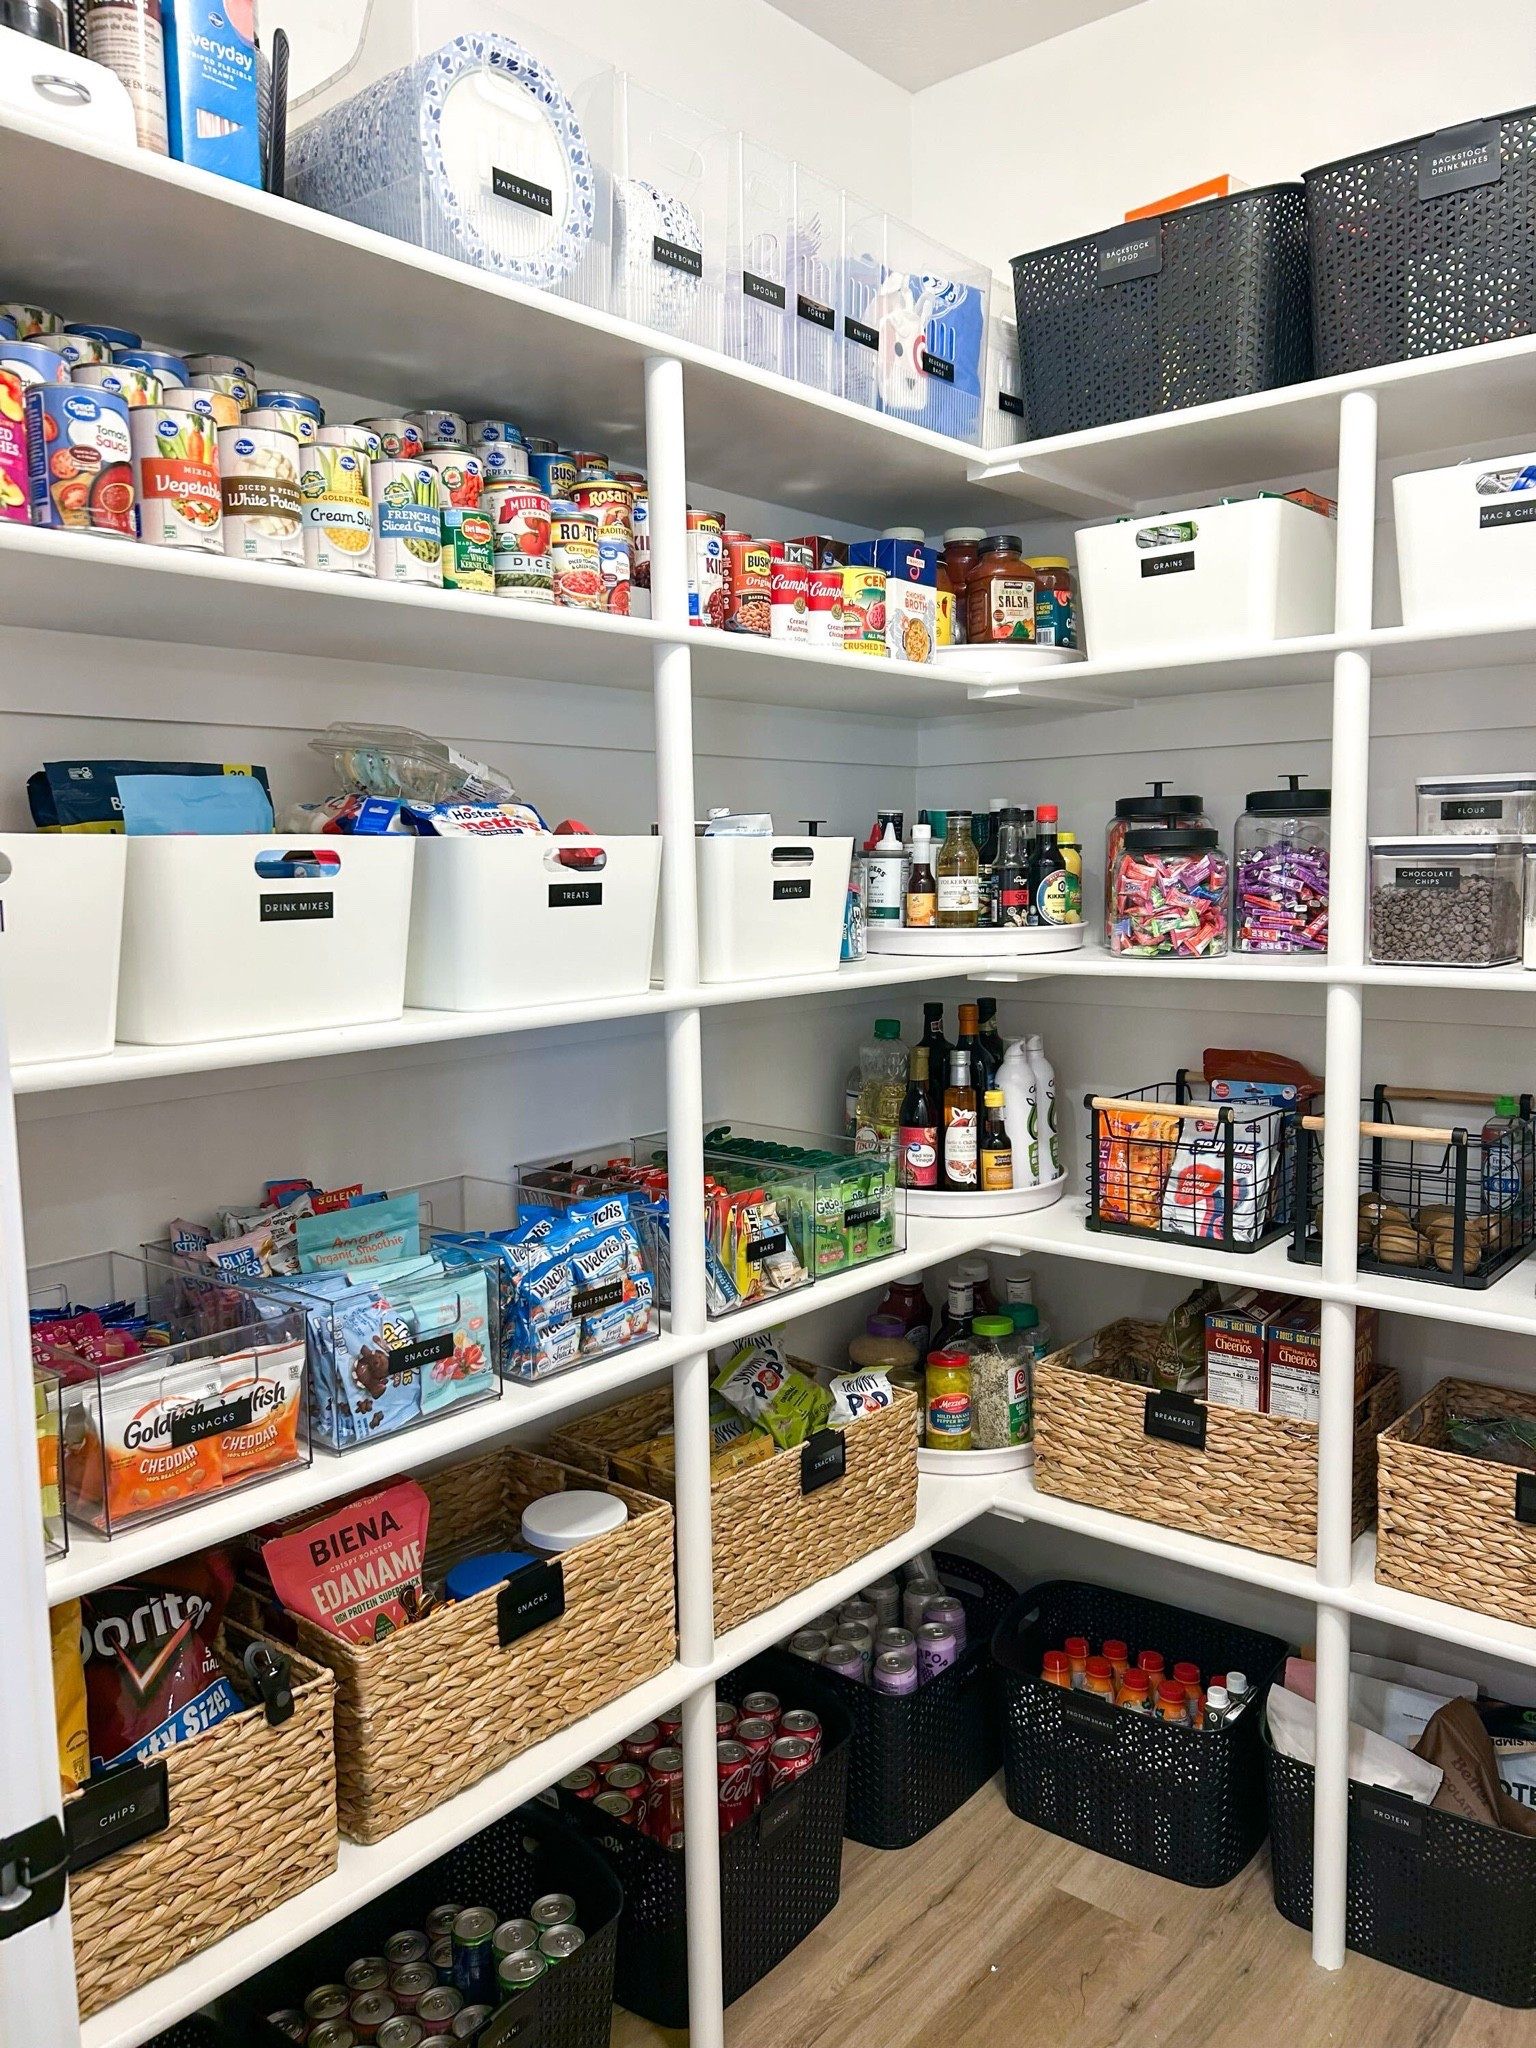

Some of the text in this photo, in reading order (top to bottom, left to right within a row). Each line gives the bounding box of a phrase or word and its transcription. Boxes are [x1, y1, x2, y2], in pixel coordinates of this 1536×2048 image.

[203, 64, 234, 82] STRAWS
[1432, 146, 1487, 167] BACKSTOCK
[1431, 155, 1488, 176] DRINK MIXES
[496, 178, 550, 206] PAPER PLATES
[657, 246, 700, 269] PAPER BOWLS
[1106, 241, 1150, 259] BACKSTOCK
[1117, 252, 1139, 264] FOOD
[752, 283, 778, 299] SPOONS
[807, 307, 826, 320] FORKS
[853, 327, 872, 342] KNIVES
[932, 365, 945, 377] BAGS
[183, 466, 212, 478] MIXED
[486, 468, 512, 477] GREAT
[238, 484, 267, 493] DICED
[227, 492, 268, 507] White
[322, 494, 354, 503] GOLDEN
[510, 498, 538, 512] MUIR
[310, 507, 355, 523] Cream
[387, 510, 430, 520] FRENCH
[1481, 510, 1512, 521] MAC &
[382, 520, 413, 532] Sliced
[1153, 560, 1183, 570] GRAINS
[905, 590, 926, 601] CHICKEN
[998, 595, 1029, 608] SALSA
[905, 597, 928, 611] BROTH
[843, 642, 878, 651] CRUSHED
[452, 810, 506, 820] Hostess
[563, 890, 590, 900] TREATS
[265, 901, 330, 913] DRINK MIXES
[1235, 1162, 1253, 1171] 80%
[318, 1189, 358, 1205] SOLELY
[846, 1208, 879, 1222] APPLESAUCE
[333, 1231, 384, 1248] Amara
[314, 1235, 404, 1267] Organic Smoothie
[579, 1237, 620, 1274] Welch's
[760, 1243, 774, 1253] BARS
[221, 1250, 251, 1270] BLUE
[573, 1290, 622, 1310] FRUIT SNACKS
[1231, 1321, 1244, 1332] GREAT
[1244, 1323, 1258, 1334] VALUE
[557, 1340, 573, 1353] Fruit
[1215, 1337, 1252, 1354] Cheerios
[1296, 1333, 1309, 1344] GREAT
[404, 1345, 440, 1363] SNACKS
[1279, 1349, 1318, 1367] Cheerios
[191, 1412, 235, 1434] SNACKS
[1154, 1411, 1195, 1427] BREAKFAST
[221, 1424, 278, 1450] CHEDDAR
[139, 1444, 199, 1475] CHEDDAR
[814, 1454, 836, 1470] SNACKS
[160, 1471, 175, 1481] REAL
[175, 1461, 197, 1477] CHEESE
[309, 1510, 401, 1567] BIENA
[329, 1541, 393, 1573] CRISPY ROASTED
[311, 1540, 422, 1616] EDAMAME
[517, 1592, 549, 1614] SNACKS
[334, 1613, 348, 1625] HIGH
[347, 1600, 379, 1619] PROTEIN
[183, 1685, 231, 1738] Size!
[1066, 1709, 1114, 1729] PROTEIN SHAKES
[99, 1804, 136, 1827] CHIPS
[773, 1810, 789, 1825] SODA
[1373, 1809, 1410, 1827] PROTEIN
